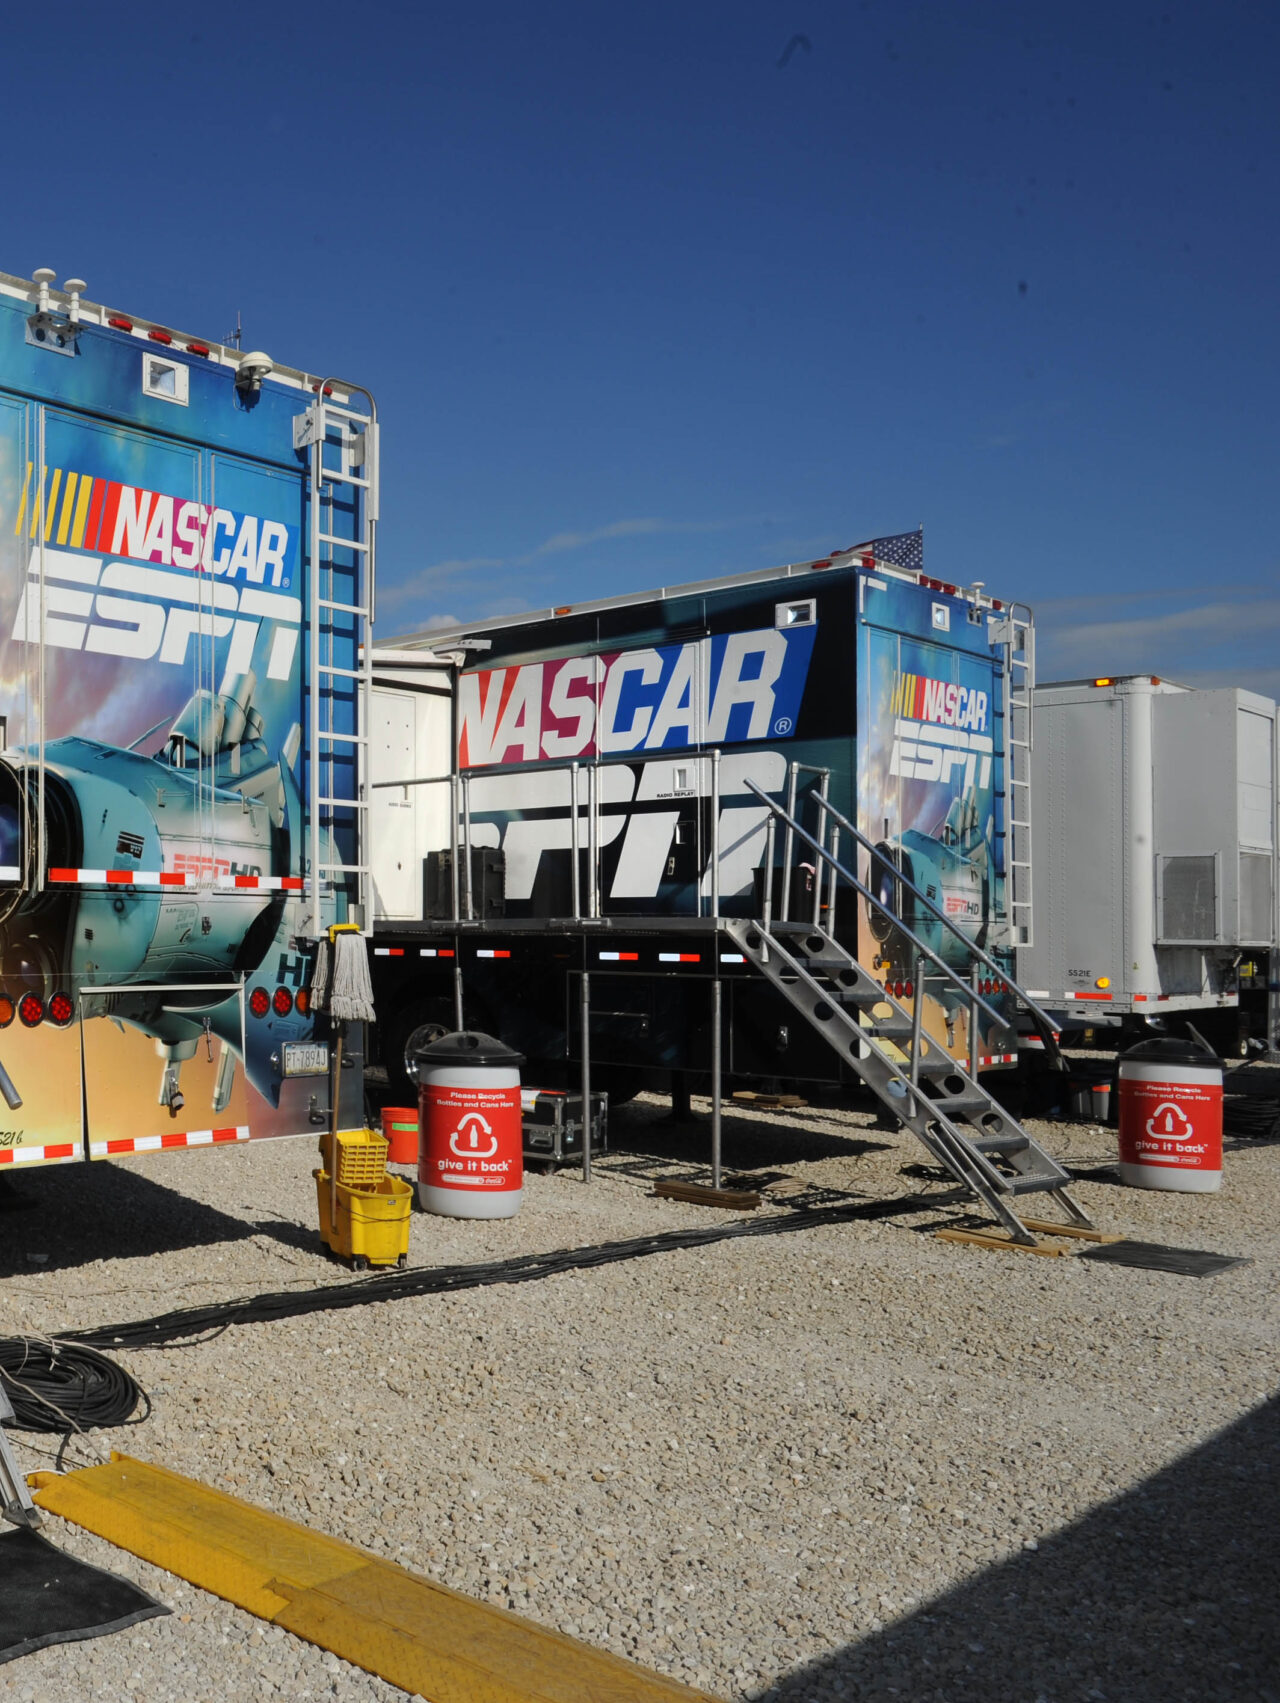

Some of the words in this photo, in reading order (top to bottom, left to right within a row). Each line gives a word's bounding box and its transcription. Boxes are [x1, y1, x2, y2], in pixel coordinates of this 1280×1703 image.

[110, 484, 290, 588] NASCAR
[11, 545, 302, 682] ESPN
[459, 627, 789, 767] NASCAR
[922, 678, 988, 732] NASCAR
[889, 718, 994, 790] ESPN
[438, 1159, 463, 1171] give
[467, 1160, 478, 1171] it
[480, 1161, 509, 1172] back
[1136, 1141, 1159, 1150] give
[1163, 1142, 1173, 1151] it
[1176, 1143, 1205, 1153] back
